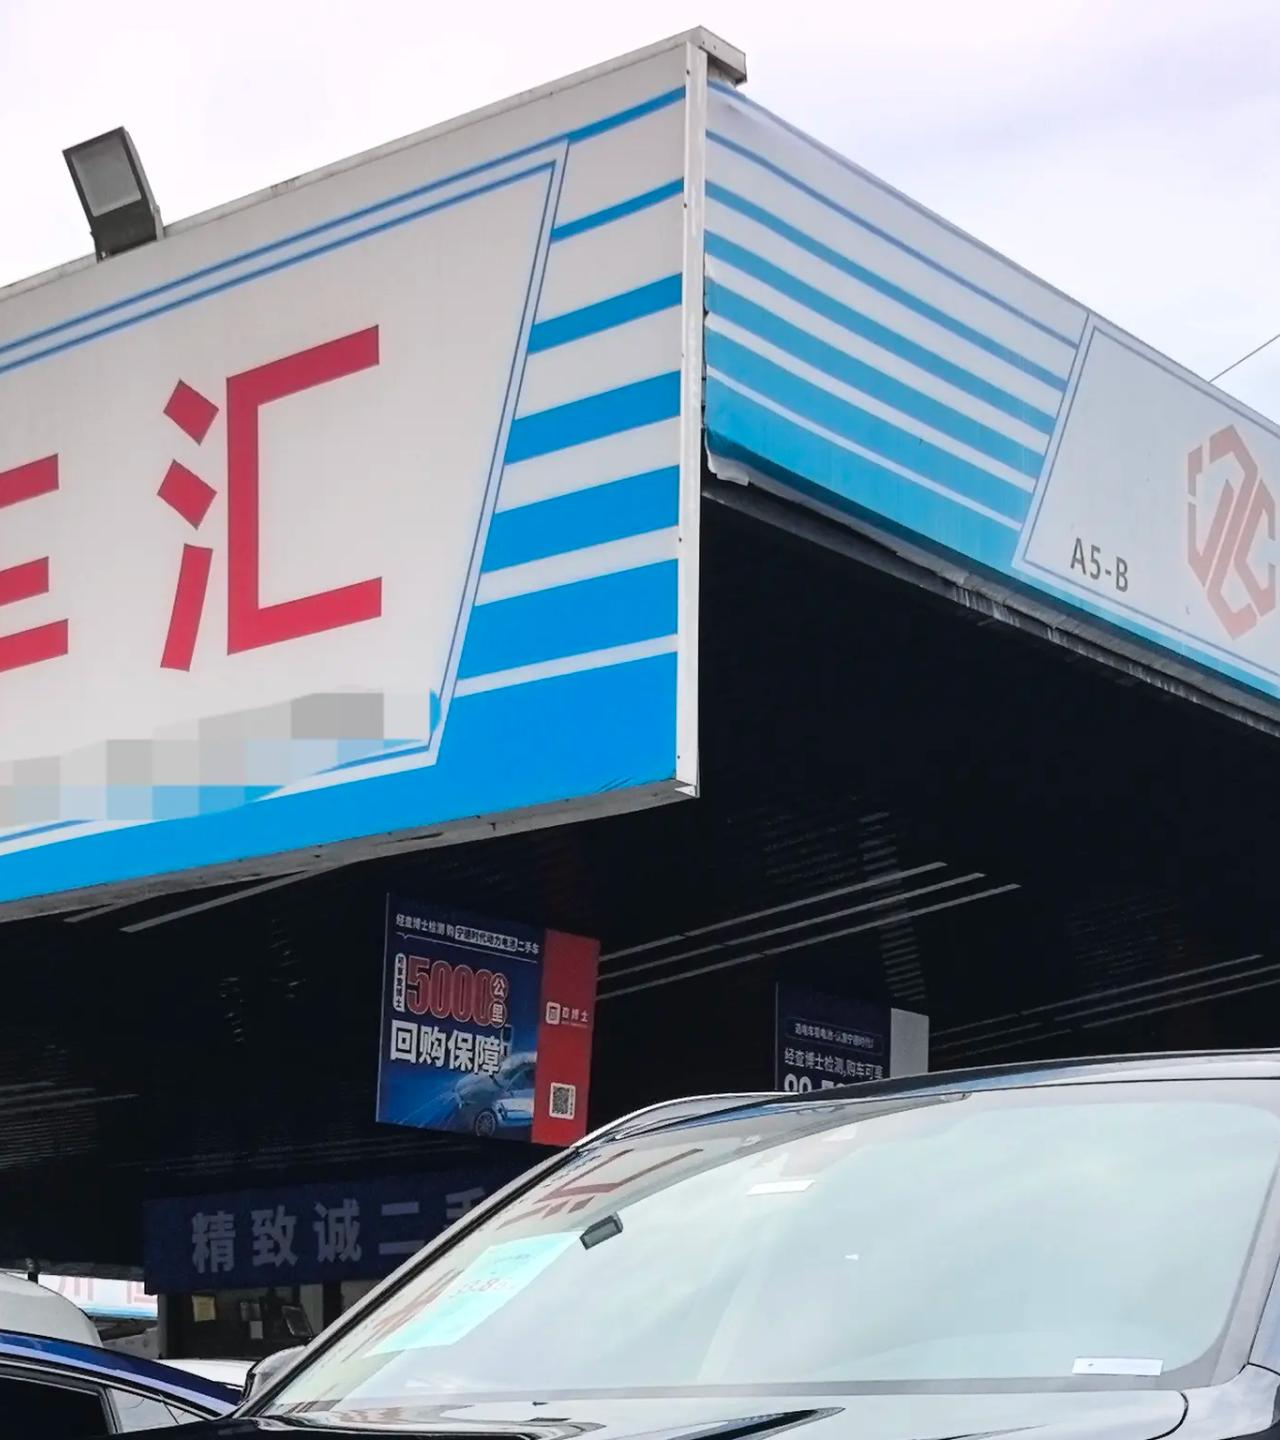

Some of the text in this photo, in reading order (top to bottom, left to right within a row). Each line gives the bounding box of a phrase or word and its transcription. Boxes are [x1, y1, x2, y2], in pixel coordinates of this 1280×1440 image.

[1071, 537, 1130, 593] A5-B
[390, 1019, 502, 1076] 回购保障
